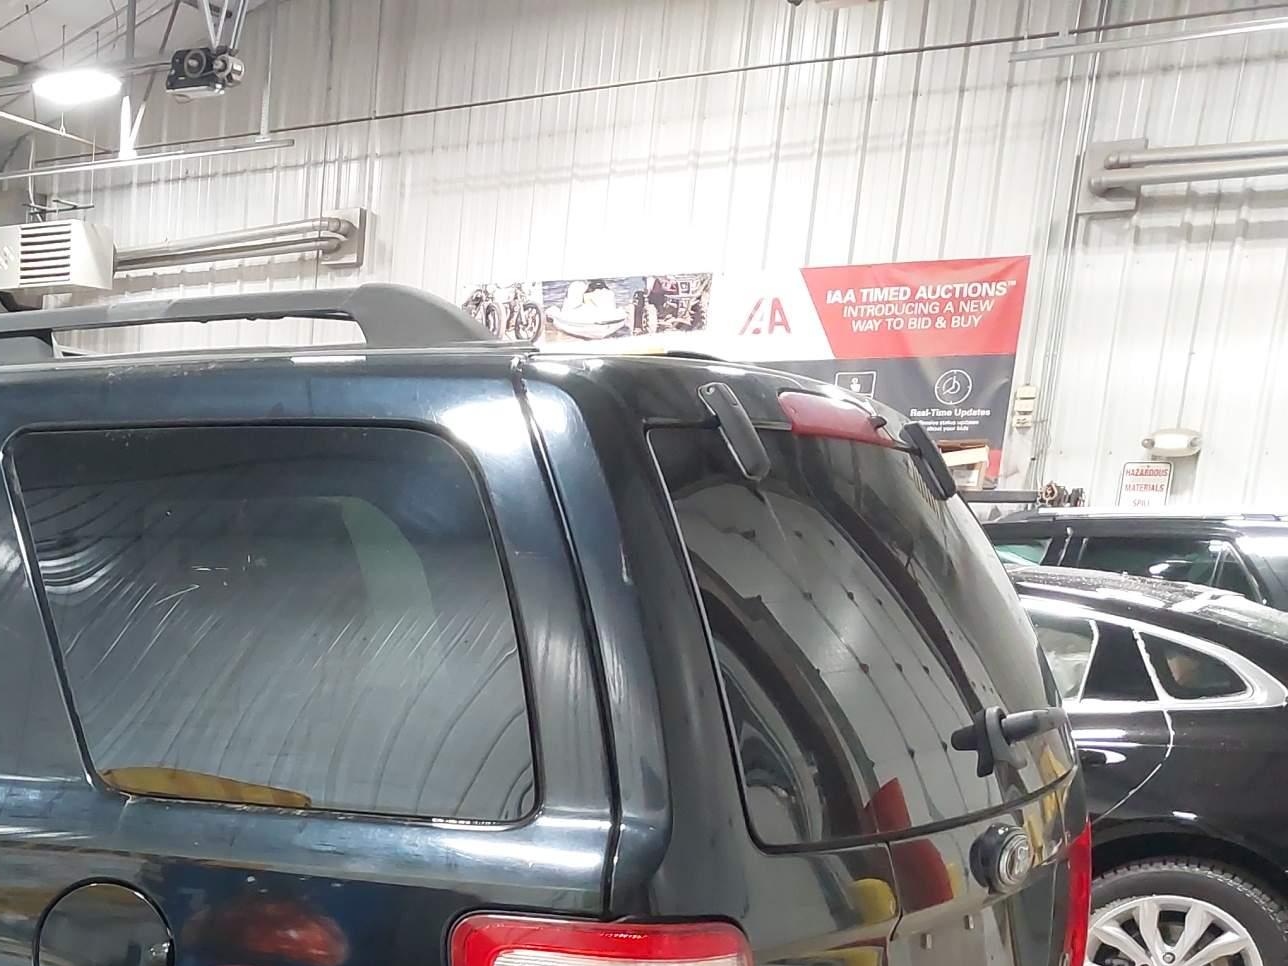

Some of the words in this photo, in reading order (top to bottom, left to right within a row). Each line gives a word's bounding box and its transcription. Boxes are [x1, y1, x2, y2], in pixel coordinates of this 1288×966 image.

[826, 289, 856, 304] IAA
[861, 286, 911, 303] TIMED
[843, 301, 940, 318] INTRODUCING
[942, 302, 955, 314] A
[959, 299, 995, 313] NEW
[851, 318, 883, 332] WAY
[885, 317, 904, 331] TO
[907, 316, 932, 330] BID
[934, 315, 947, 329] &
[951, 314, 983, 328] BUY
[953, 408, 991, 418] Updates
[1125, 468, 1169, 477] HAZARDOUS
[1124, 483, 1165, 492] MATERIALS
